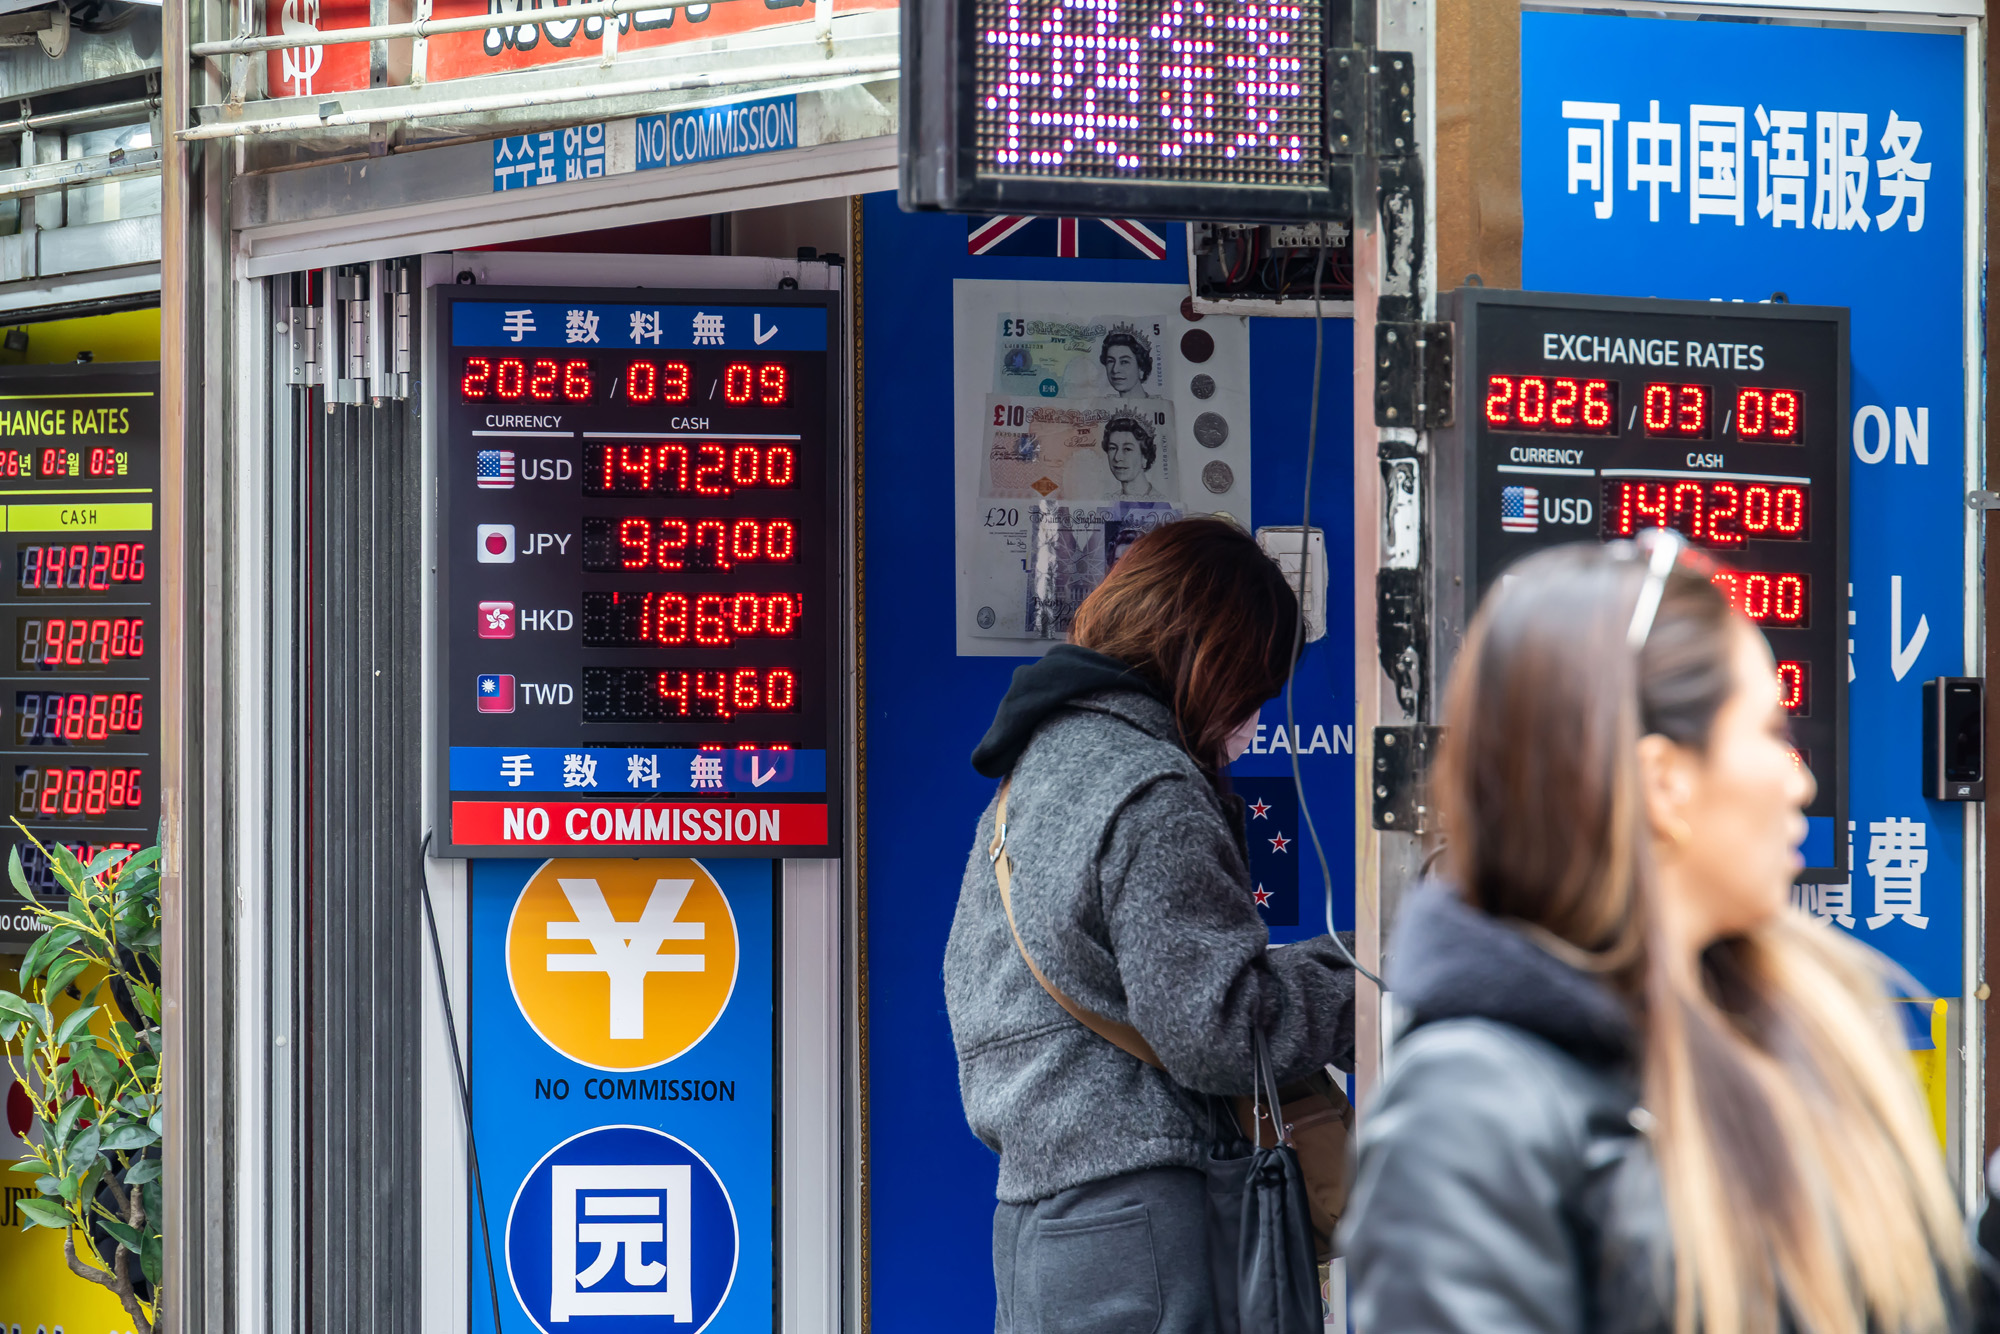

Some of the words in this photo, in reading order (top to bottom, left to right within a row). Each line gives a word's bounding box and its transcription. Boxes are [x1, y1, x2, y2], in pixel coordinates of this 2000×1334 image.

[637, 119, 667, 164] NO
[672, 101, 794, 162] COMMISSION
[494, 133, 557, 191] 수수료
[563, 123, 604, 182] 없음
[1562, 99, 1932, 233] 可中国语服务
[1003, 319, 1025, 337] £5
[1153, 323, 1160, 336] 5
[1543, 333, 1679, 367] EXCHANGE
[1686, 341, 1765, 372] RATES
[0, 409, 66, 436] HANGE
[72, 407, 129, 435] RATES
[485, 414, 562, 428] CURRENCY
[671, 417, 710, 430] CASH
[993, 404, 1025, 426] £10
[1154, 411, 1165, 426] 10
[1510, 446, 1584, 466] CURRENCY
[1686, 452, 1724, 469] CASH
[521, 458, 573, 481] USD
[60, 509, 97, 525] CASH
[983, 507, 1019, 528] £20
[1543, 497, 1593, 525] USD
[522, 533, 572, 556] JPY
[520, 609, 574, 631] HKD
[520, 683, 574, 705] TWD
[1241, 724, 1353, 755] EALAN
[503, 807, 550, 841] NO
[565, 807, 780, 842] COMMISSION
[534, 1077, 570, 1100] NO
[583, 1077, 736, 1102] COMMISSION
